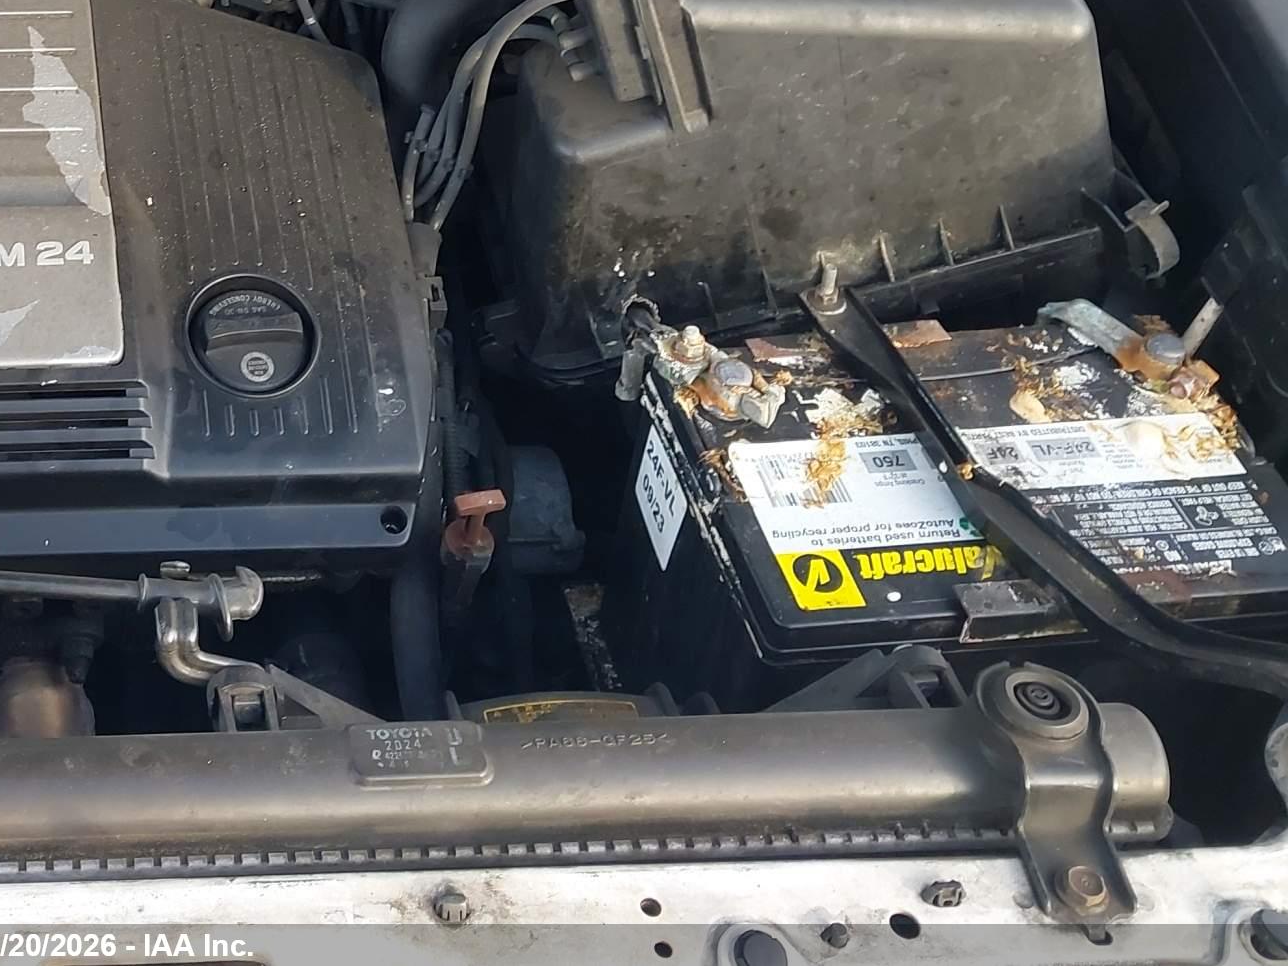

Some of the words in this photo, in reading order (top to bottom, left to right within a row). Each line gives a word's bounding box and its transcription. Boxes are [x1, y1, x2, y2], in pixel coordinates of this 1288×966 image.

[36, 240, 95, 266] 24
[872, 456, 905, 468] 750
[833, 523, 871, 535] proper
[880, 522, 892, 531] for
[895, 518, 954, 529] AutoZone
[773, 526, 827, 539] recycling
[884, 530, 914, 540] used
[918, 529, 961, 538] Return
[811, 536, 823, 545] to
[827, 533, 883, 545] batteries
[366, 727, 433, 740] TOYOTA
